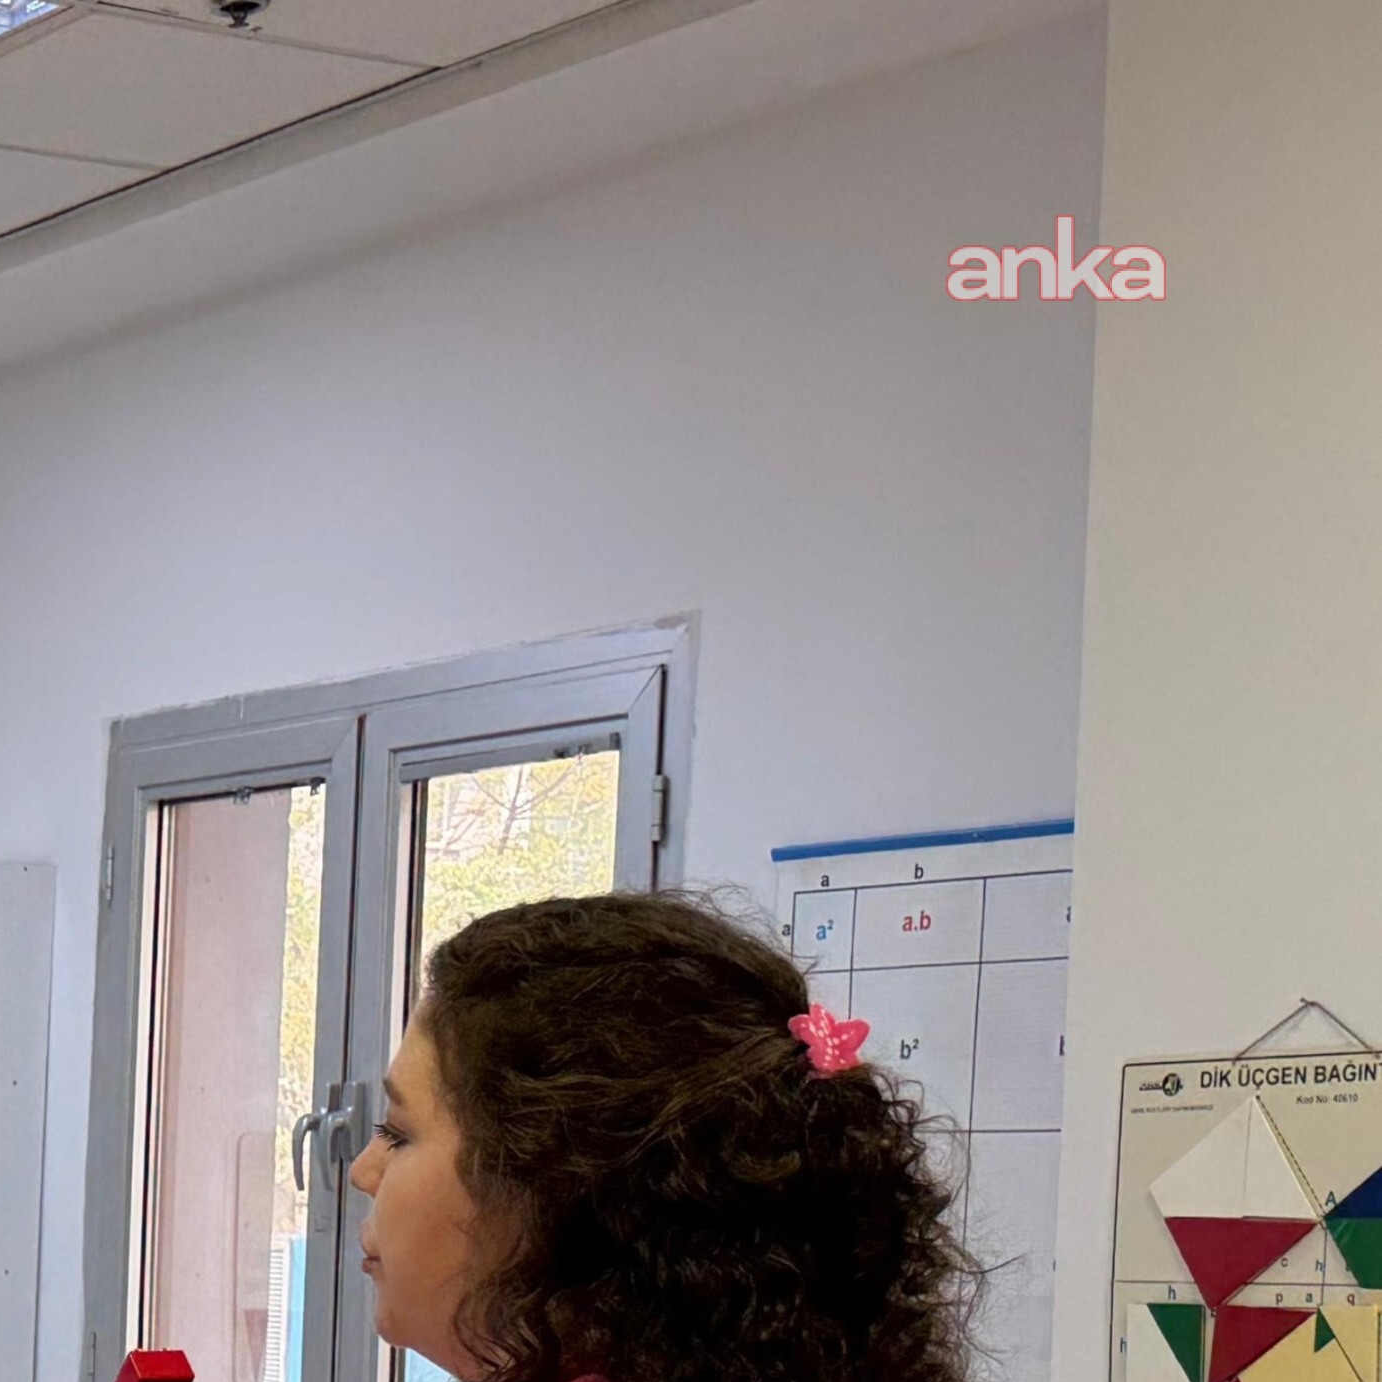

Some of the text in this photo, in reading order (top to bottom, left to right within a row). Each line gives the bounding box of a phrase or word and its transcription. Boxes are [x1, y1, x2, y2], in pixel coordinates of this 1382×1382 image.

[913, 863, 924, 880] b
[820, 874, 831, 888] a
[902, 910, 932, 932] a.b
[782, 923, 791, 936] a
[1200, 1066, 1232, 1089] DİK
[1238, 1064, 1308, 1090] ÜÇGEN
[1325, 1191, 1337, 1206] A
[1167, 1285, 1177, 1300] h
